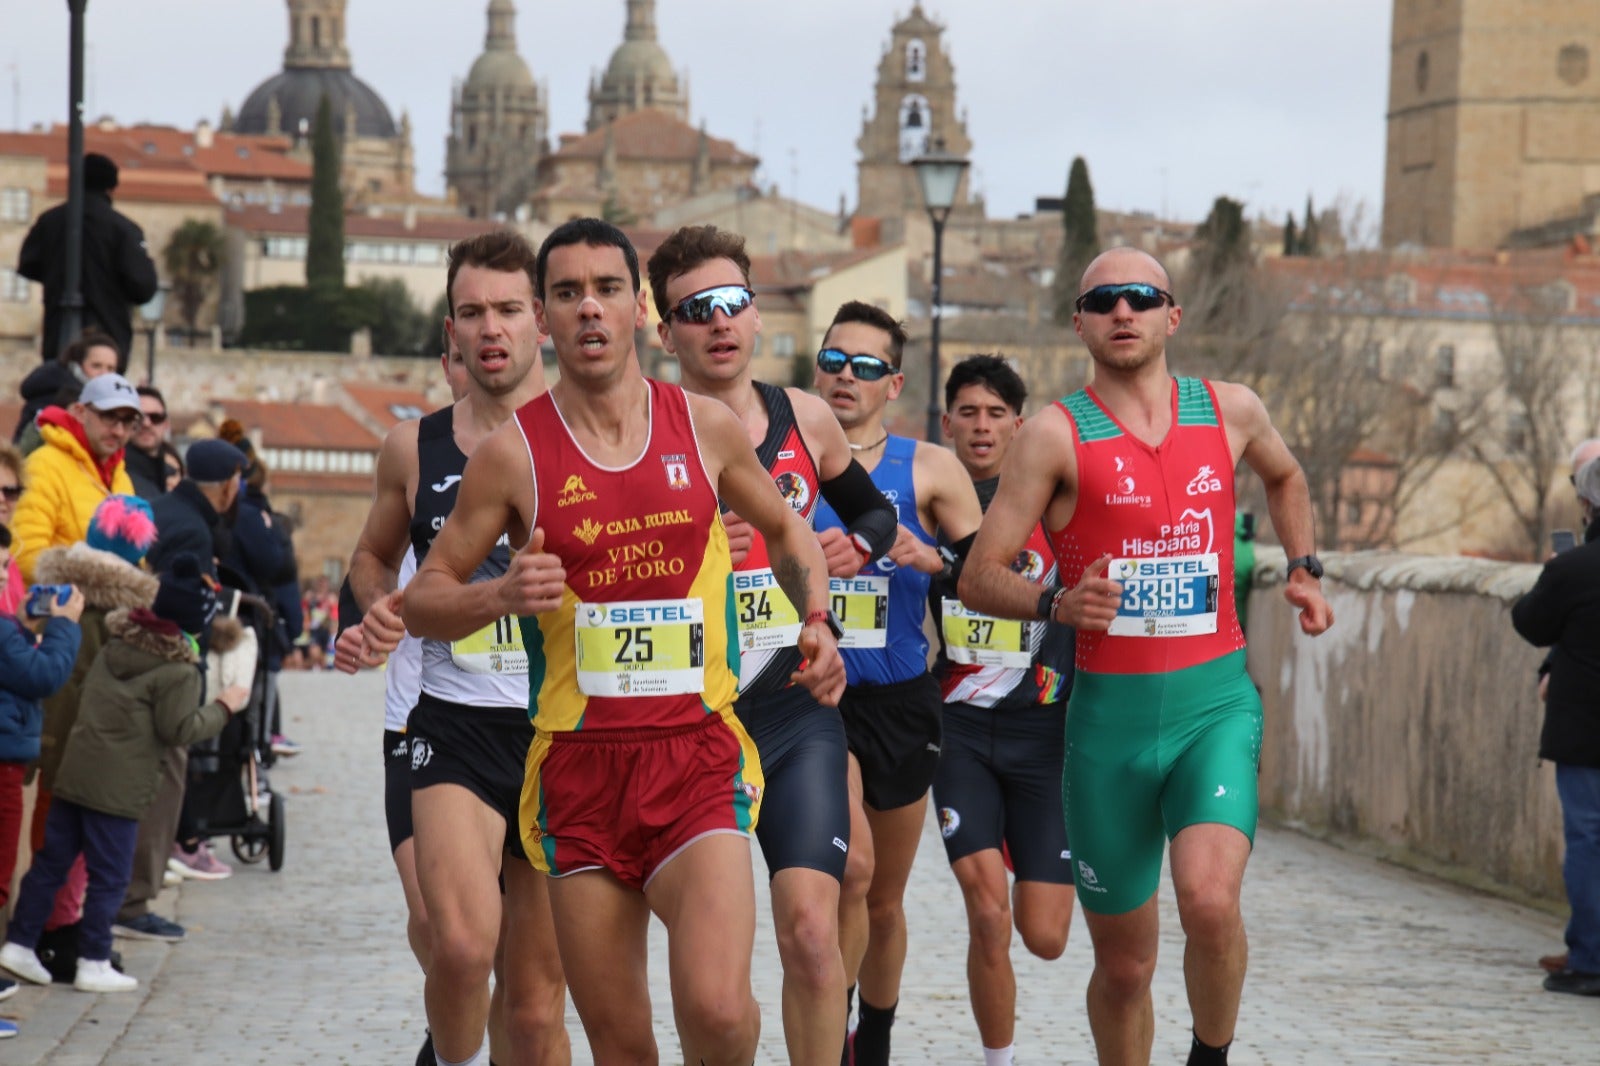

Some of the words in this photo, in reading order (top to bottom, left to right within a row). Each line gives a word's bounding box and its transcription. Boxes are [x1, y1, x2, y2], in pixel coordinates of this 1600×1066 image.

[606, 517, 643, 535] CAJA
[644, 509, 693, 529] RURAL
[1160, 521, 1200, 538] Patria
[606, 540, 664, 564] VINO
[1122, 534, 1201, 558] Hispana
[588, 567, 618, 588] DE
[622, 557, 685, 581] TORO
[735, 573, 773, 589] SET
[1140, 561, 1209, 576] SETEL
[829, 580, 878, 592] ETEL
[1124, 577, 1194, 611] 3395
[610, 605, 692, 623] SETEL
[739, 590, 772, 623] 34
[832, 595, 846, 622] 0
[967, 619, 995, 645] 37
[614, 627, 653, 663] 25
